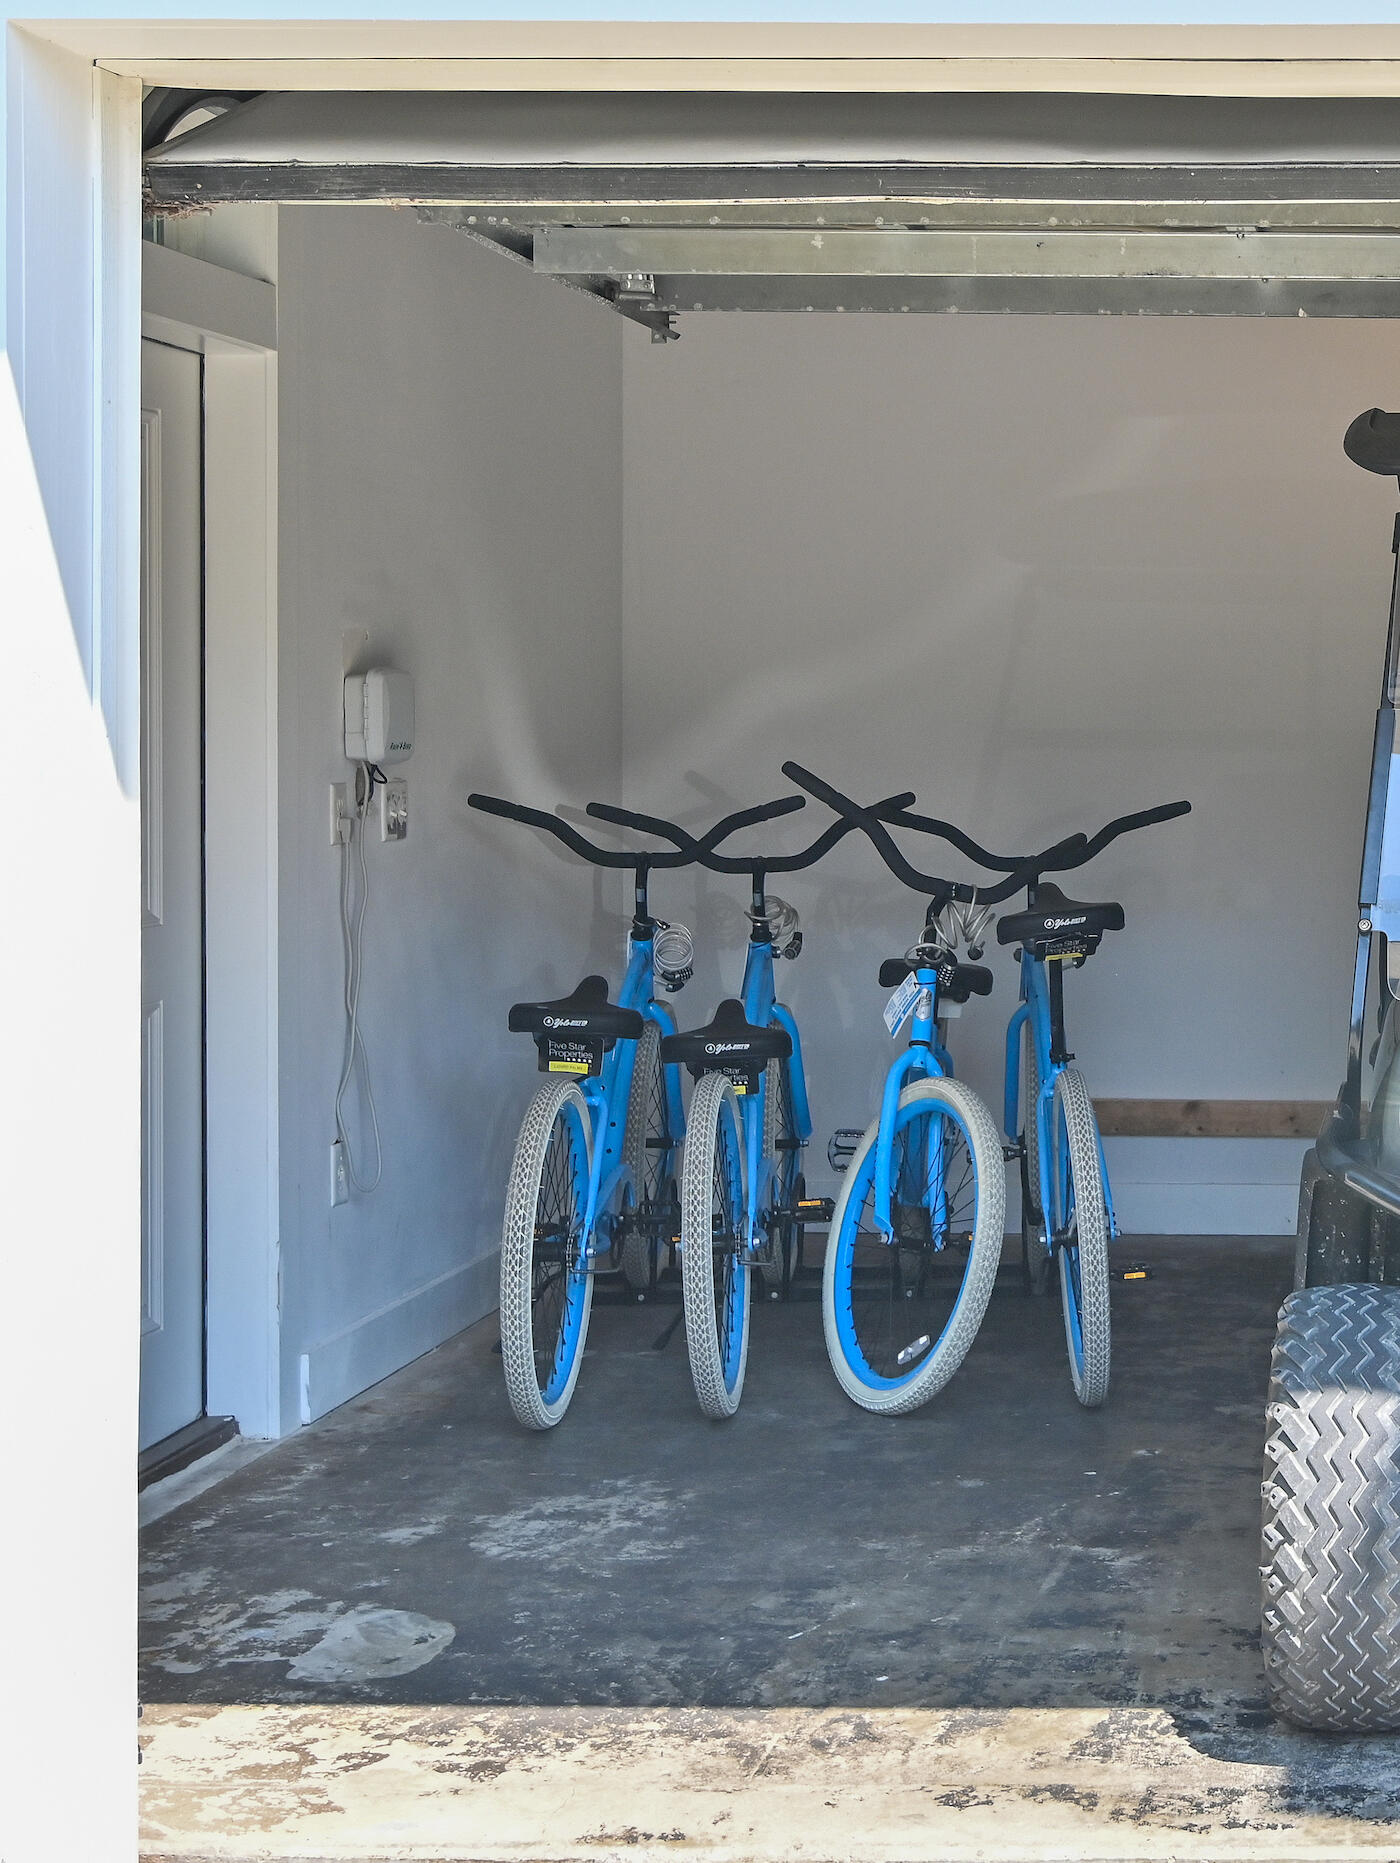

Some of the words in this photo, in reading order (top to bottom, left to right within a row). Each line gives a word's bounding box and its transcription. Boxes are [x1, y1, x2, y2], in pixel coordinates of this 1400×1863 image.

[548, 1039, 567, 1050] Five
[568, 1041, 587, 1051] Star
[548, 1048, 594, 1061] Properties
[722, 1066, 742, 1075] Star
